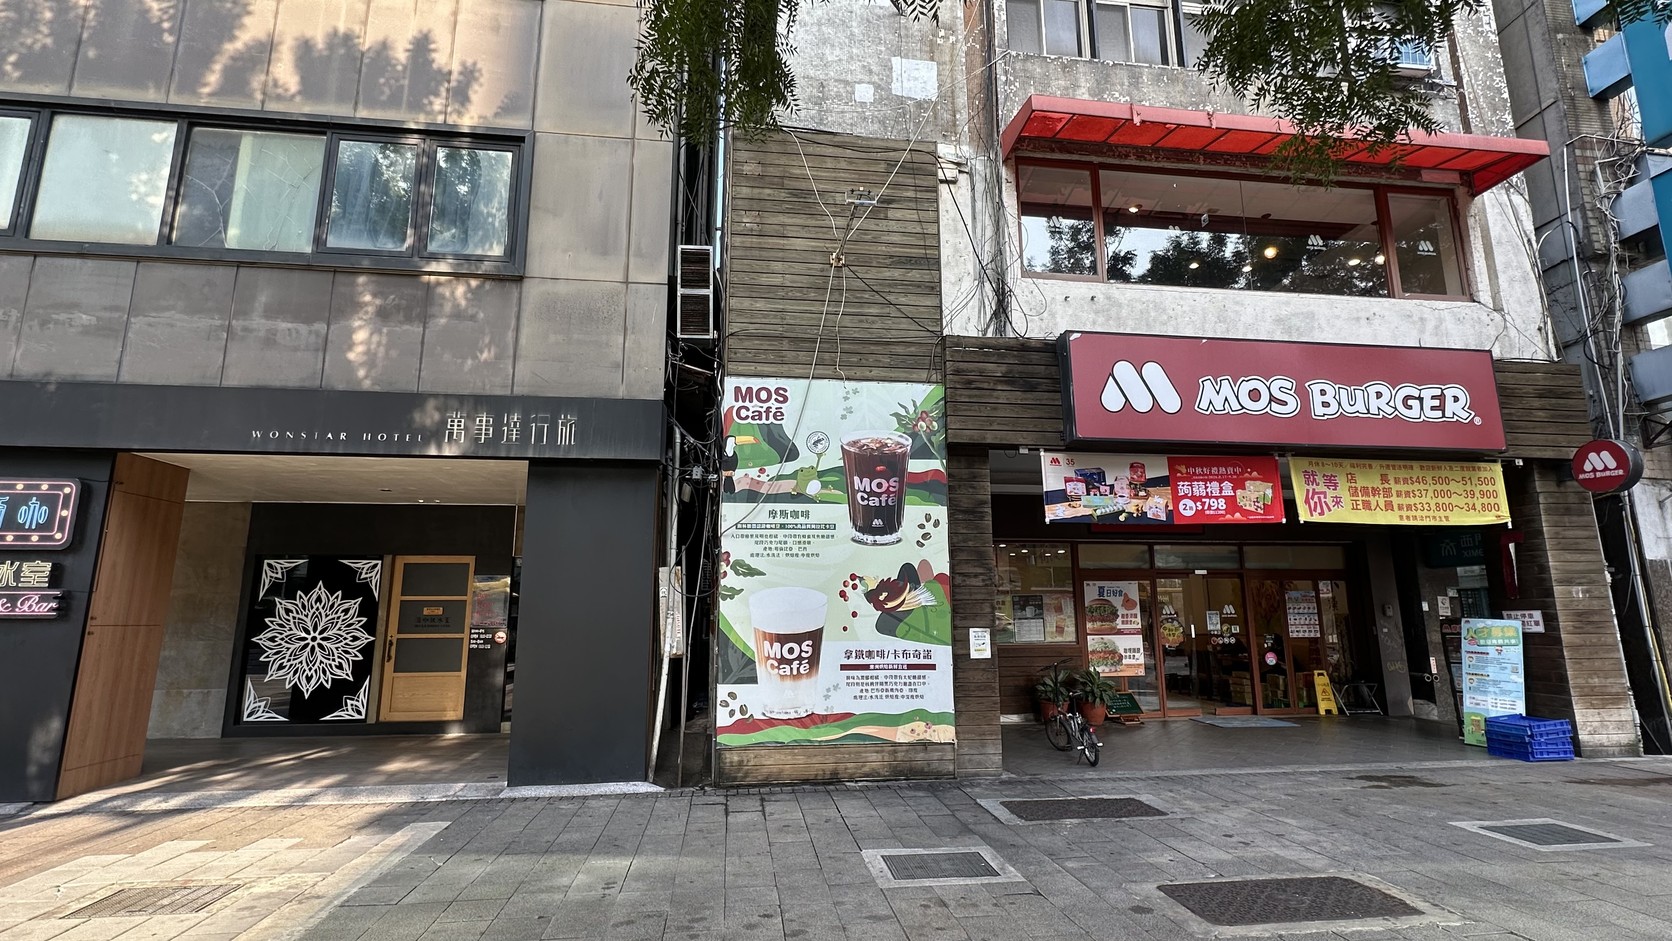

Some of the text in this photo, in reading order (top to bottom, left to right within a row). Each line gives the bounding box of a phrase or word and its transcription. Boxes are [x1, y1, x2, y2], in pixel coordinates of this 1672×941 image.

[733, 385, 789, 405] MOS
[1195, 374, 1475, 423] MOS BURGER
[735, 405, 785, 422] Café
[445, 411, 577, 446] 萬事達行旅
[1065, 458, 1076, 466] 35
[1187, 466, 1242, 475] 中秋好禮熱賣中
[1578, 469, 1624, 480] MOS BURGER
[854, 475, 900, 495] MOS
[1177, 481, 1235, 497] 蒟蒻禮盒
[856, 491, 899, 507] Café
[1196, 498, 1227, 511] $798
[1350, 499, 1396, 512] 正職人員
[0, 497, 49, 530] 咖
[768, 509, 811, 520] 摩斯咖啡
[15, 595, 59, 613] Bar
[763, 640, 814, 661] MOS
[844, 649, 932, 660] 拿鐵咖啡/卡布奇諾
[765, 658, 811, 676] Café
